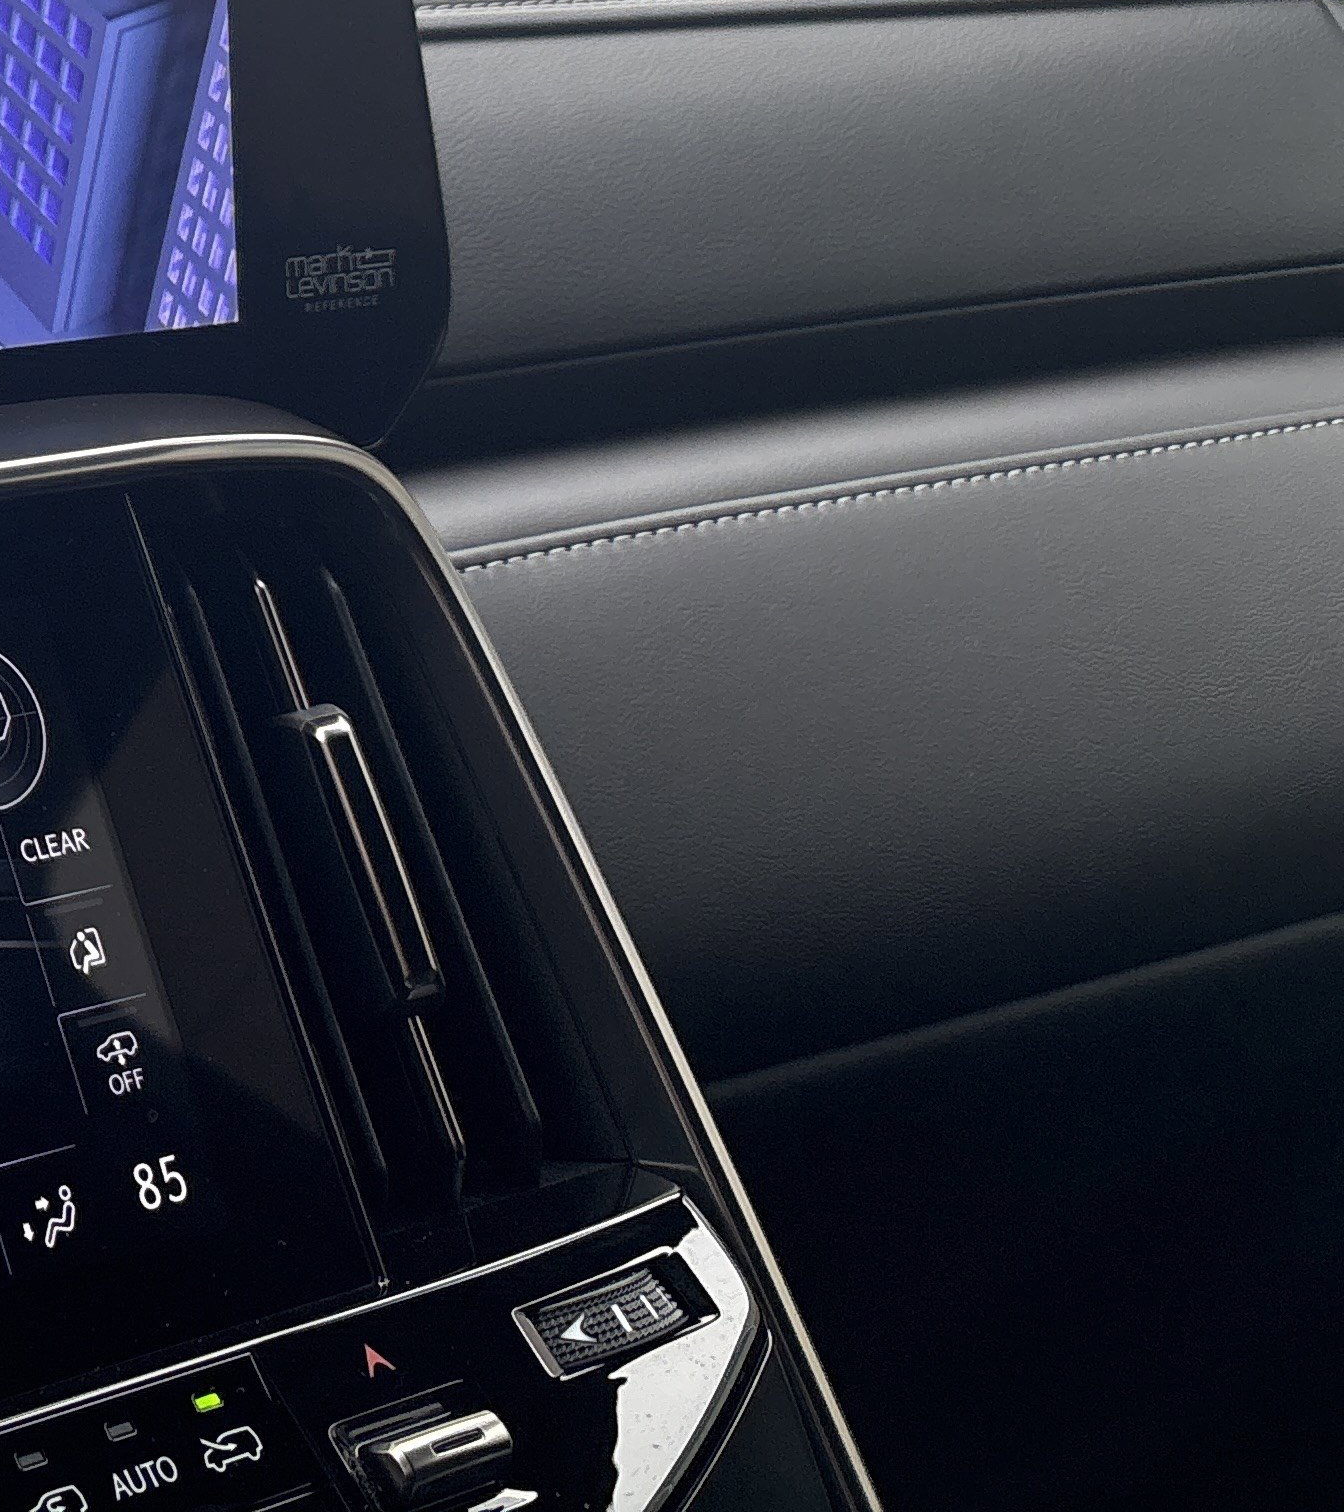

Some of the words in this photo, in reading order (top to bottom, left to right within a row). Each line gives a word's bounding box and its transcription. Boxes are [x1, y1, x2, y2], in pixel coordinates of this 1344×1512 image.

[20, 827, 90, 862] CLEAR
[109, 1068, 144, 1095] OFF
[133, 1155, 187, 1210] 85
[112, 1456, 178, 1501] AUTO
